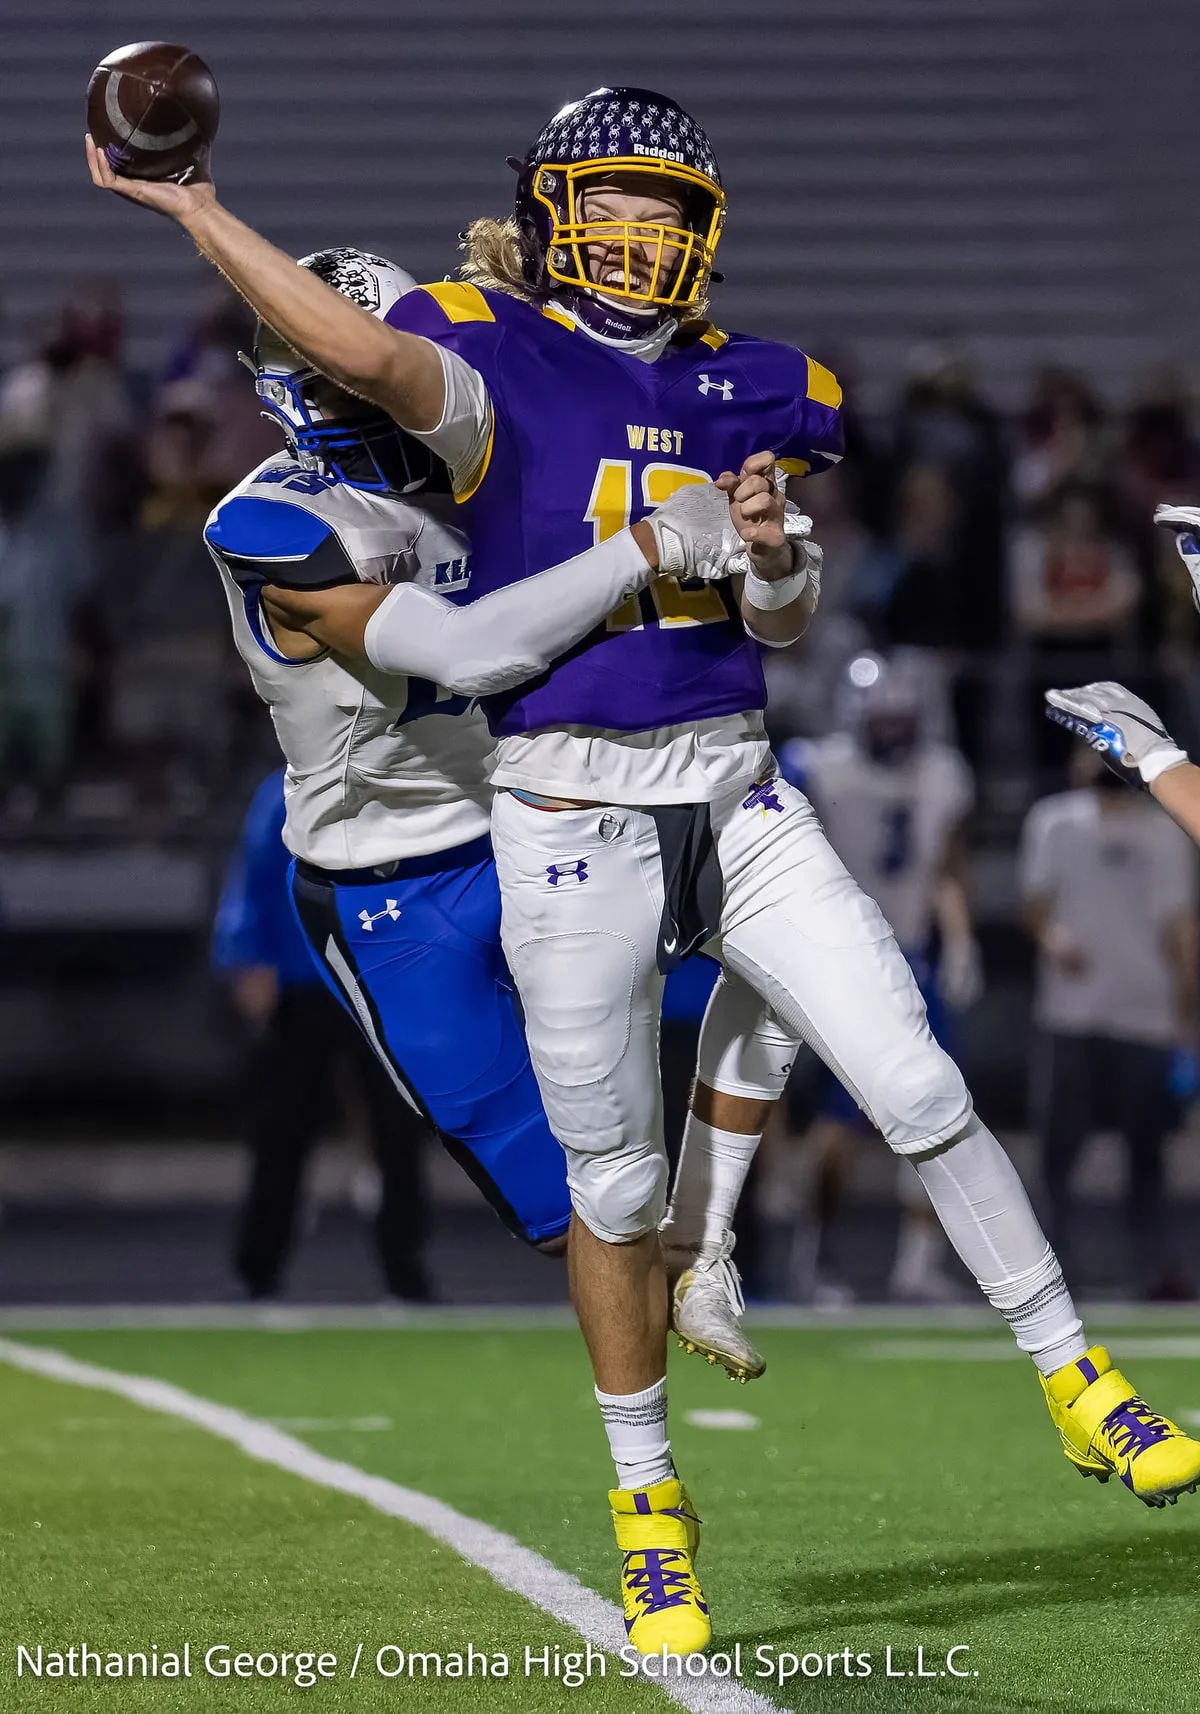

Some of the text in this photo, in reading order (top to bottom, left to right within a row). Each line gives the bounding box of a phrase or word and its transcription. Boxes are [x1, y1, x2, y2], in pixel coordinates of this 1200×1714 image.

[633, 143, 684, 163] Riddell
[605, 318, 632, 333] Riddell
[626, 424, 684, 455] WEST
